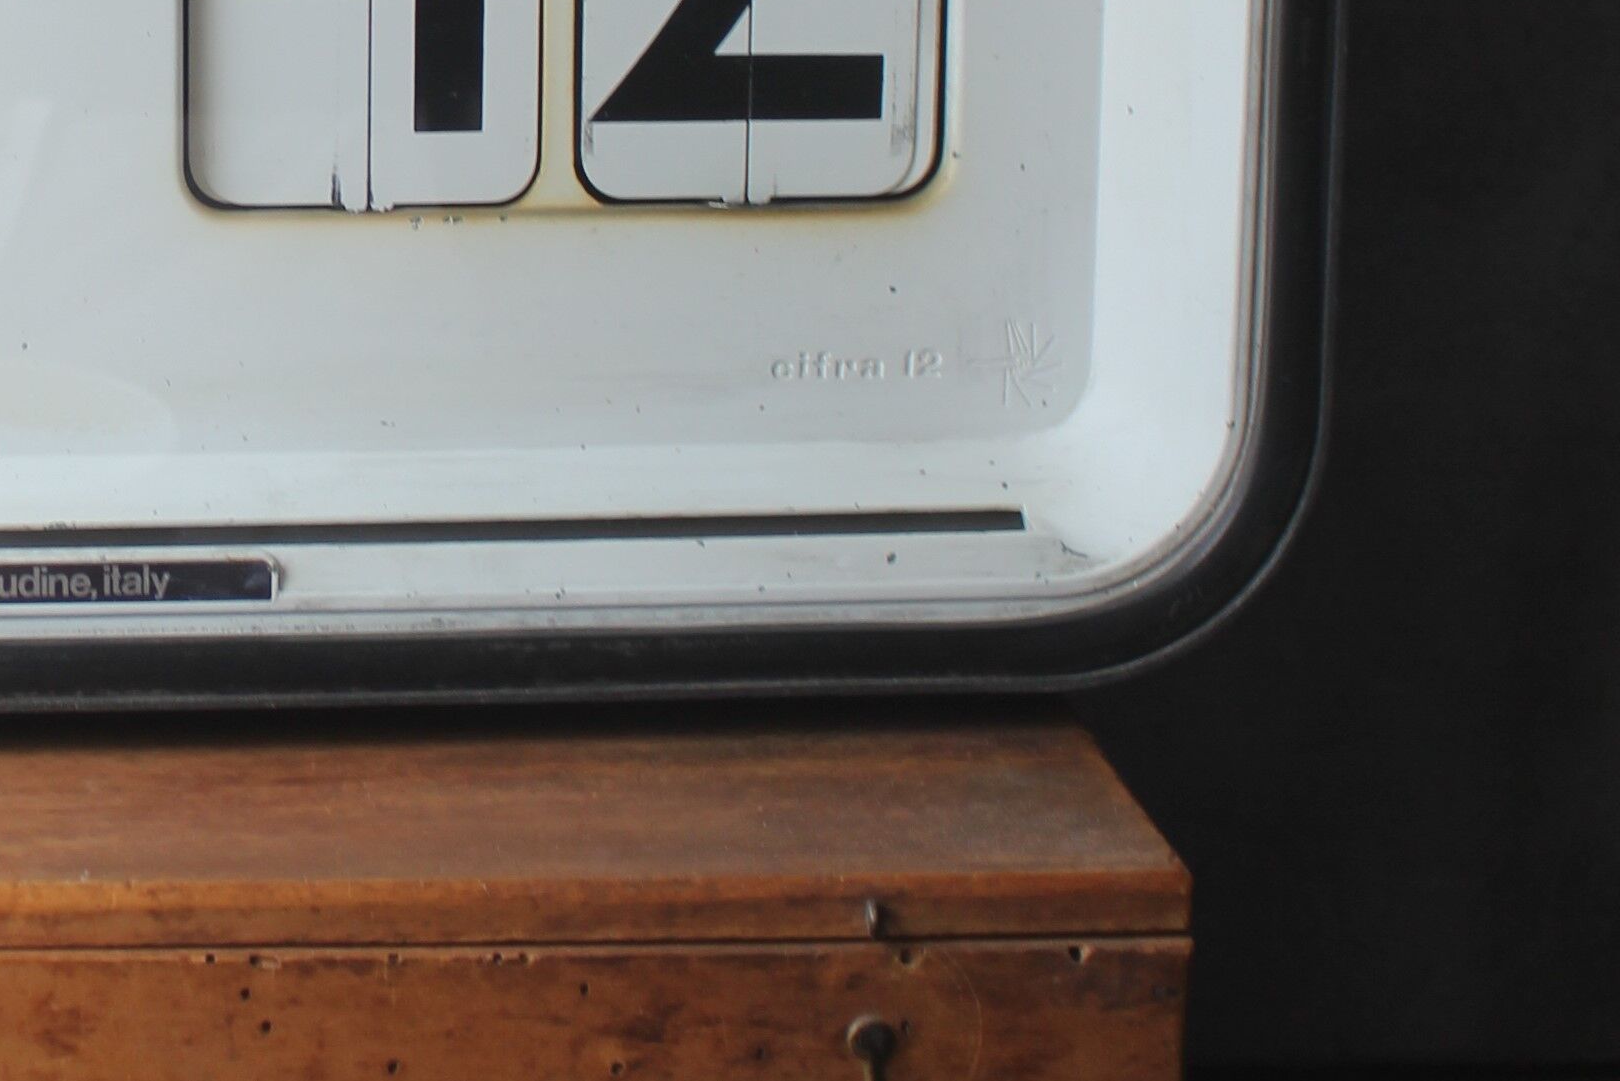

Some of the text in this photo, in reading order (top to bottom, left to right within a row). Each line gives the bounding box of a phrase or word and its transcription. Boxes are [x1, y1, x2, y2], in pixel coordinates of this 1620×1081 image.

[771, 349, 943, 379] cifra 12
[103, 564, 171, 600] italy
